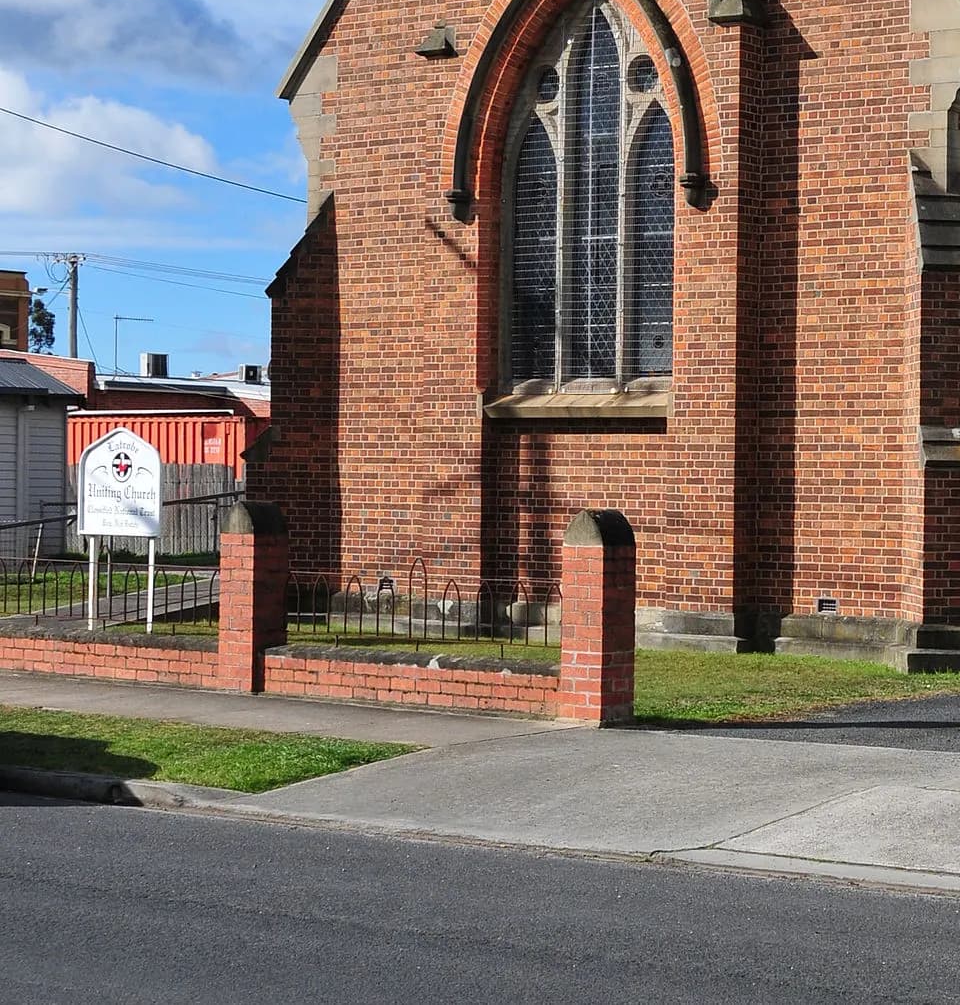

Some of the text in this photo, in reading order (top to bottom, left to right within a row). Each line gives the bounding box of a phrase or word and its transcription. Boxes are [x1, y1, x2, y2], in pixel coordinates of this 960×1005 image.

[107, 441, 139, 453] Latrobe
[88, 483, 156, 502] Uniting Church
